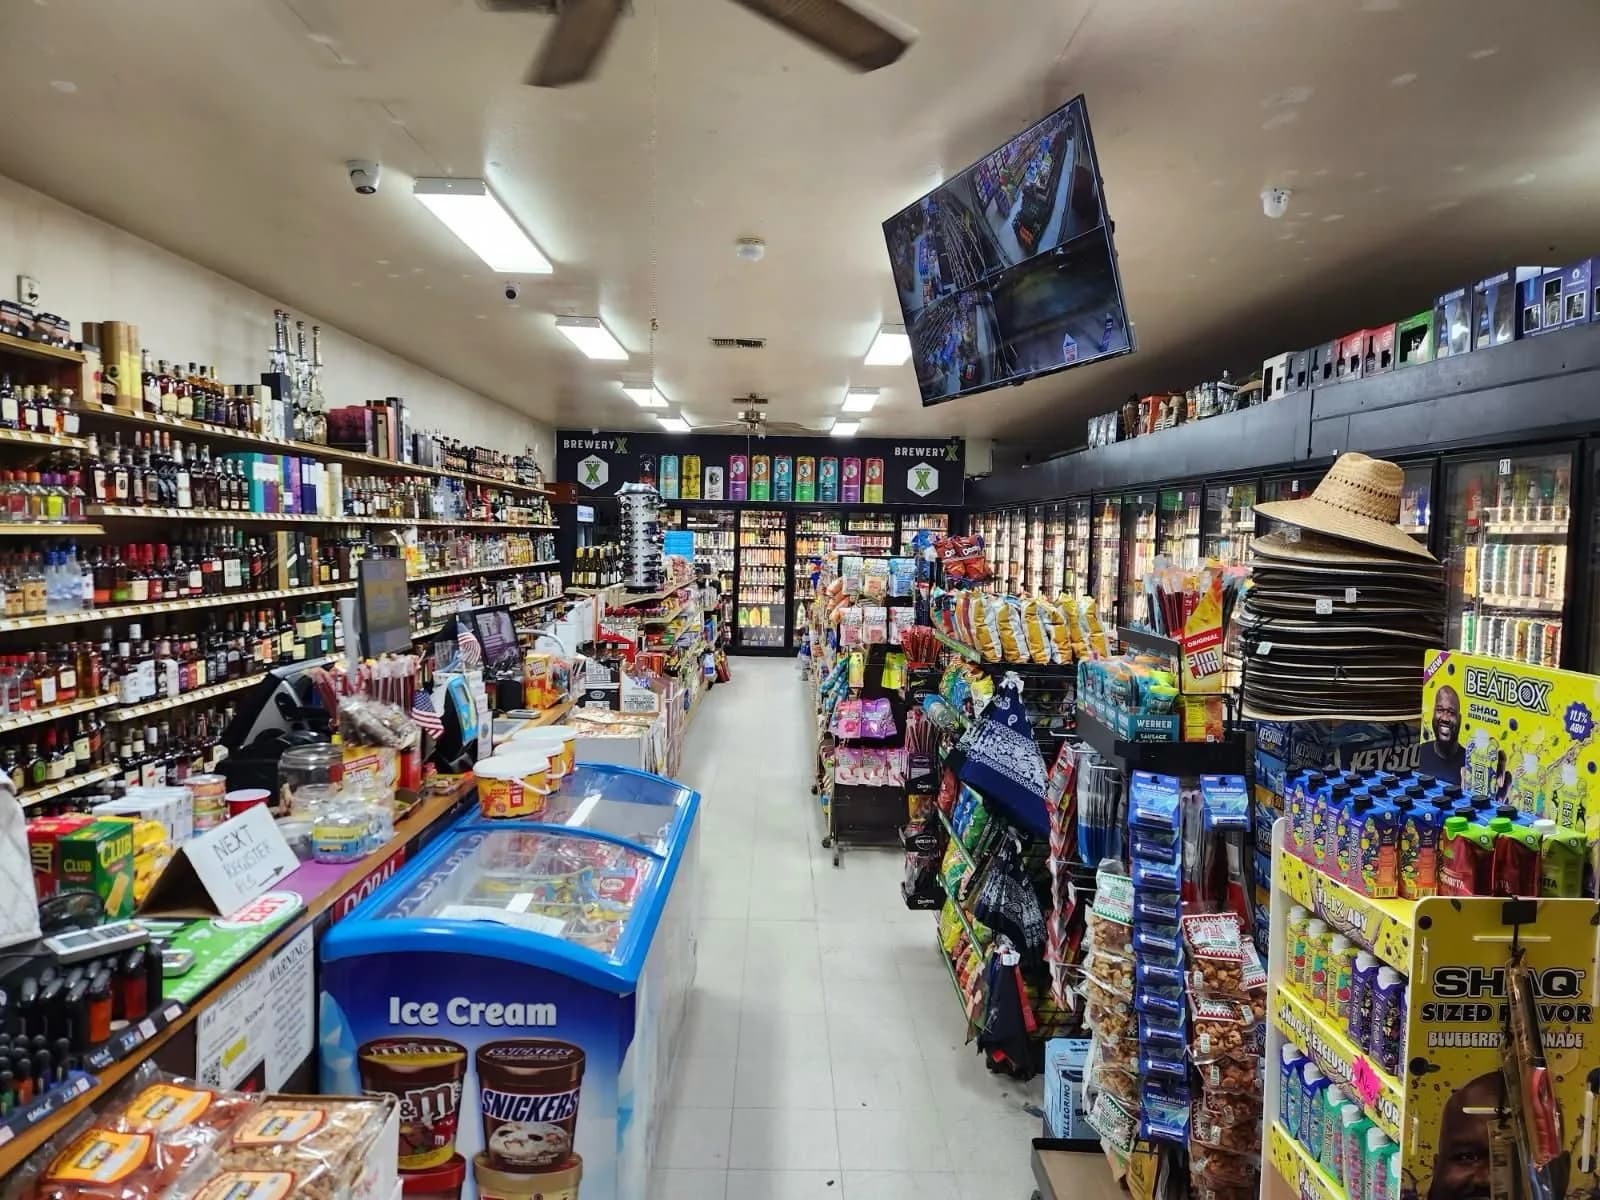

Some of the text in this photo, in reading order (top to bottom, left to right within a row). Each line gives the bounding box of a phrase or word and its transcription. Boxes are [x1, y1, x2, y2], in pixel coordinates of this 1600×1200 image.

[1501, 461, 1510, 474] 21
[1187, 633, 1219, 648] ORIGINAL
[1428, 655, 1444, 676] NEW
[1467, 669, 1550, 713] BEATBOX
[1470, 703, 1499, 718] SHAQ
[1137, 719, 1172, 728] WERNER
[1570, 722, 1585, 733] ABV
[100, 834, 132, 870] CLUB
[212, 824, 254, 861] NEXT
[31, 842, 53, 874] RITZ
[63, 859, 92, 873] CLUB
[223, 839, 273, 879] REGISTER
[389, 996, 557, 1026] Ice Cream
[1421, 1003, 1593, 1024] SIZED FVOR
[1428, 1030, 1506, 1048] BLUEBERRY
[482, 1088, 580, 1123] SNICKERS
